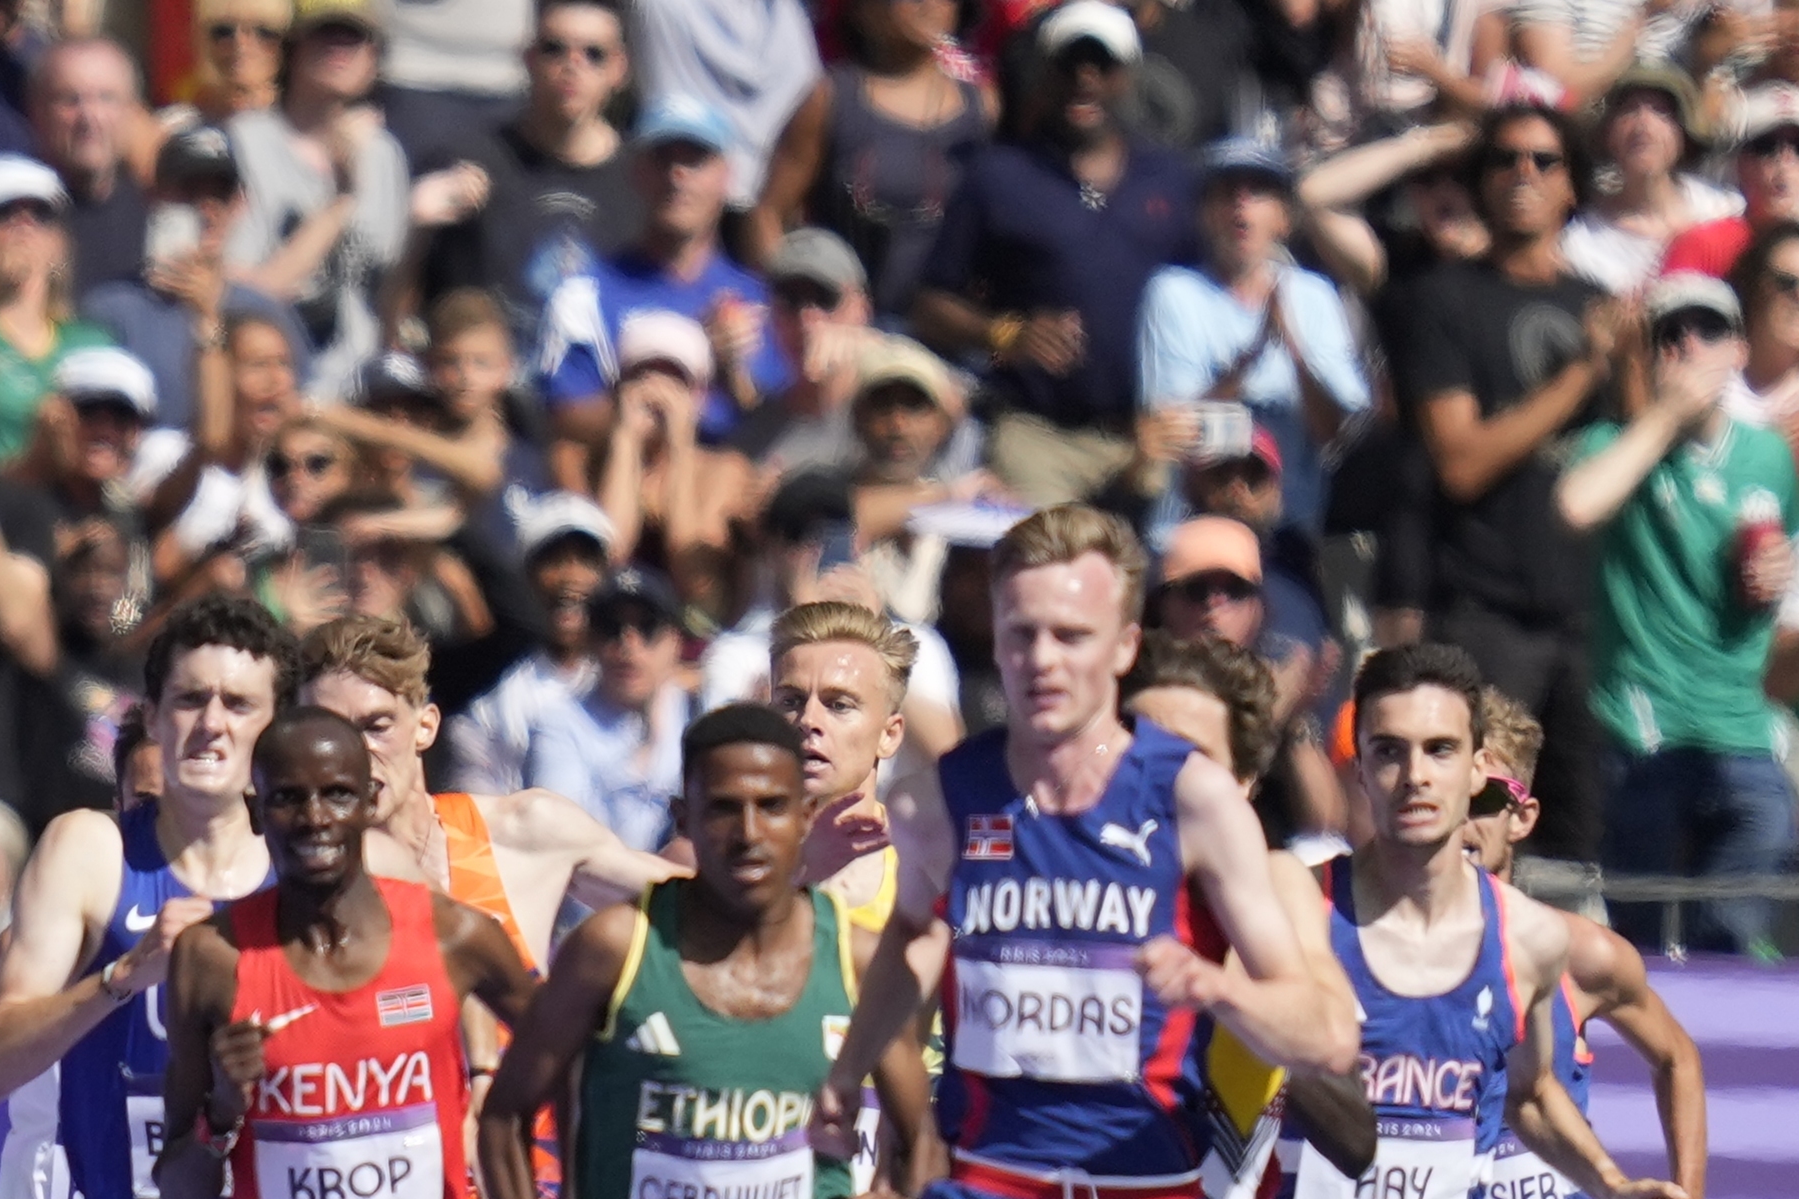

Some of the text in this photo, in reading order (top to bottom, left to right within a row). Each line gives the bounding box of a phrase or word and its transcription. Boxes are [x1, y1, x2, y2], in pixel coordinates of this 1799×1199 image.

[963, 876, 1156, 938] NORWAY
[258, 1051, 433, 1115] KENYA
[636, 1079, 814, 1142] ETHIOPI
[1359, 1053, 1482, 1111] RANCE
[1376, 1122, 1399, 1136] RIS
